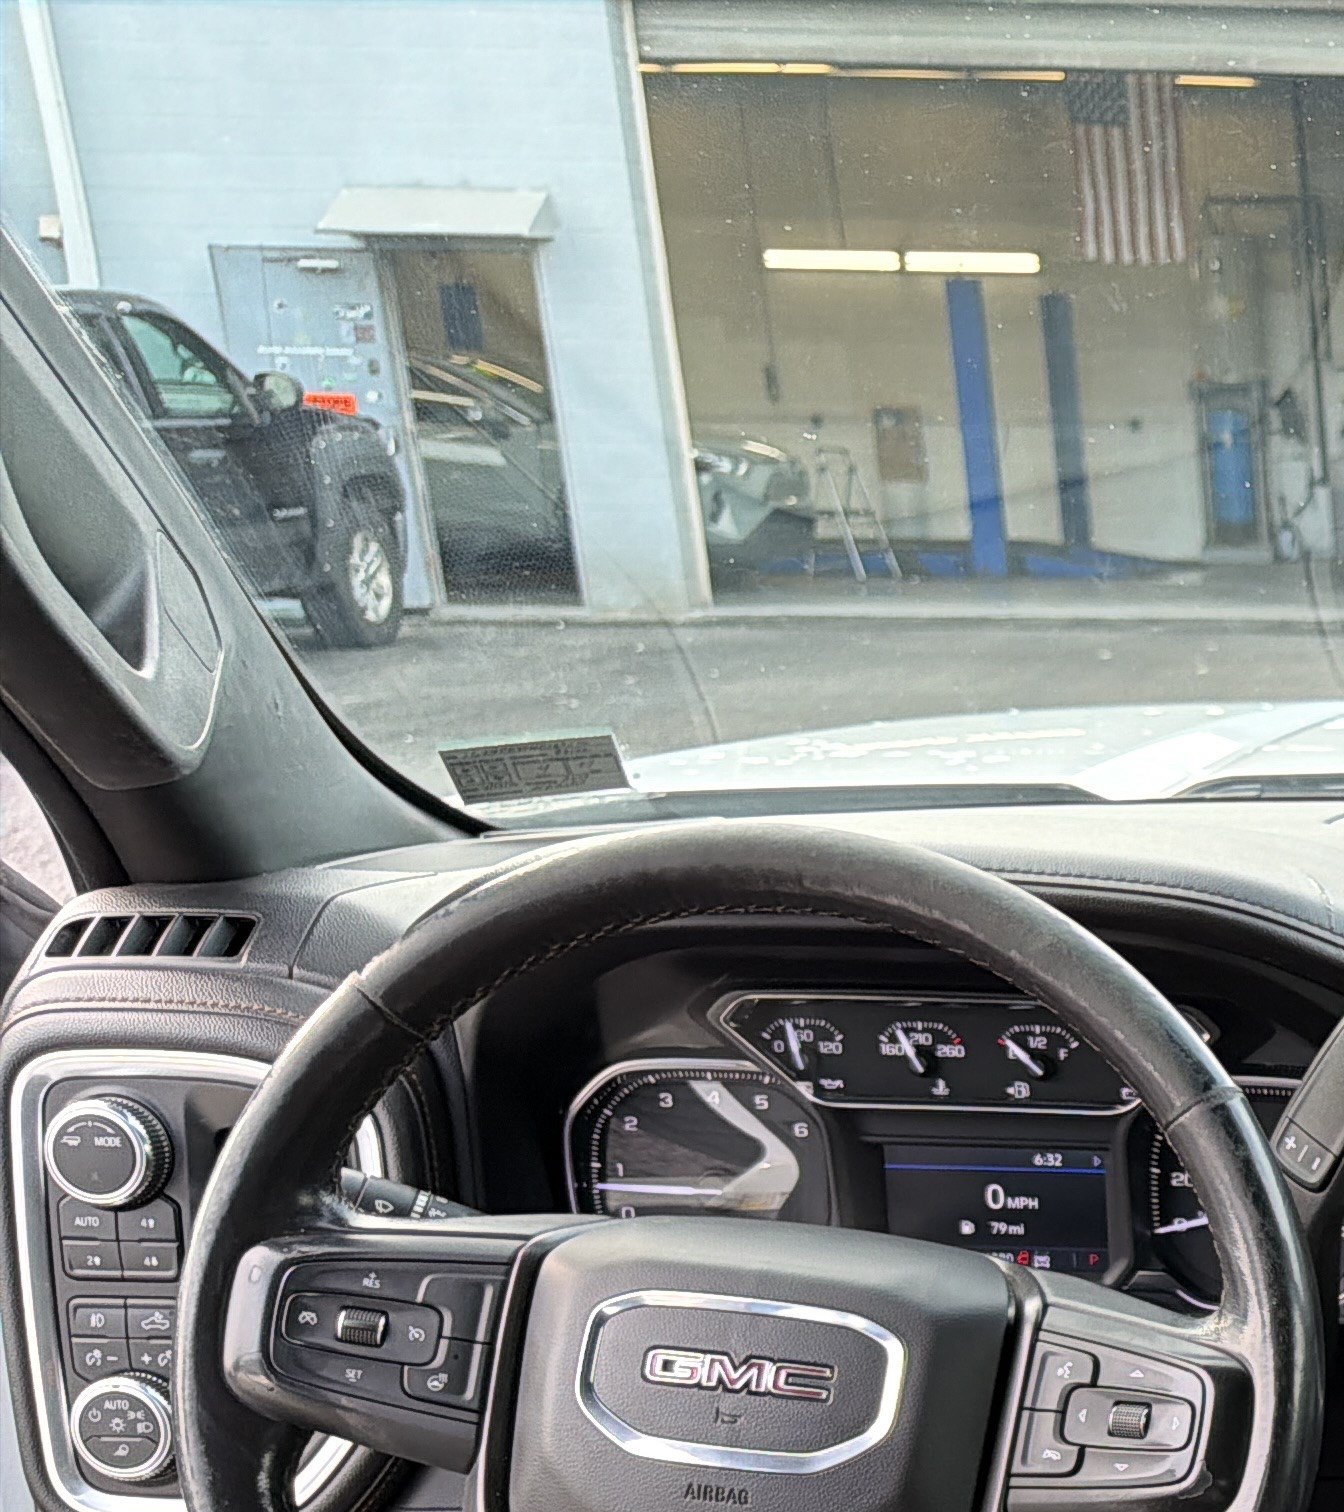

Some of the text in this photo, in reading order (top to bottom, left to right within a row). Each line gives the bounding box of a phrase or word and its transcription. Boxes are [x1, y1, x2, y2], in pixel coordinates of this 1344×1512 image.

[773, 1040, 785, 1052] 0
[909, 1032, 933, 1046] 210
[818, 1041, 843, 1054] 120
[878, 1043, 905, 1056] 160
[935, 1044, 965, 1058] 260
[1059, 1048, 1069, 1060] F
[658, 1093, 674, 1108] 3
[706, 1091, 721, 1105] 4
[754, 1094, 769, 1110] 5
[623, 1116, 639, 1132] 2
[793, 1122, 809, 1138] 6
[94, 1136, 122, 1147] MODE
[1032, 1152, 1063, 1167] 6:32
[615, 1162, 624, 1177] 1
[984, 1183, 1039, 1210] 0 MPH
[74, 1216, 100, 1227] AUTO
[989, 1221, 1007, 1235] 79
[362, 1277, 381, 1289] RES
[344, 1368, 363, 1380] SET
[645, 1347, 838, 1404] GMC
[103, 1399, 130, 1411] AUTO
[683, 1481, 749, 1506] AIRBAG
